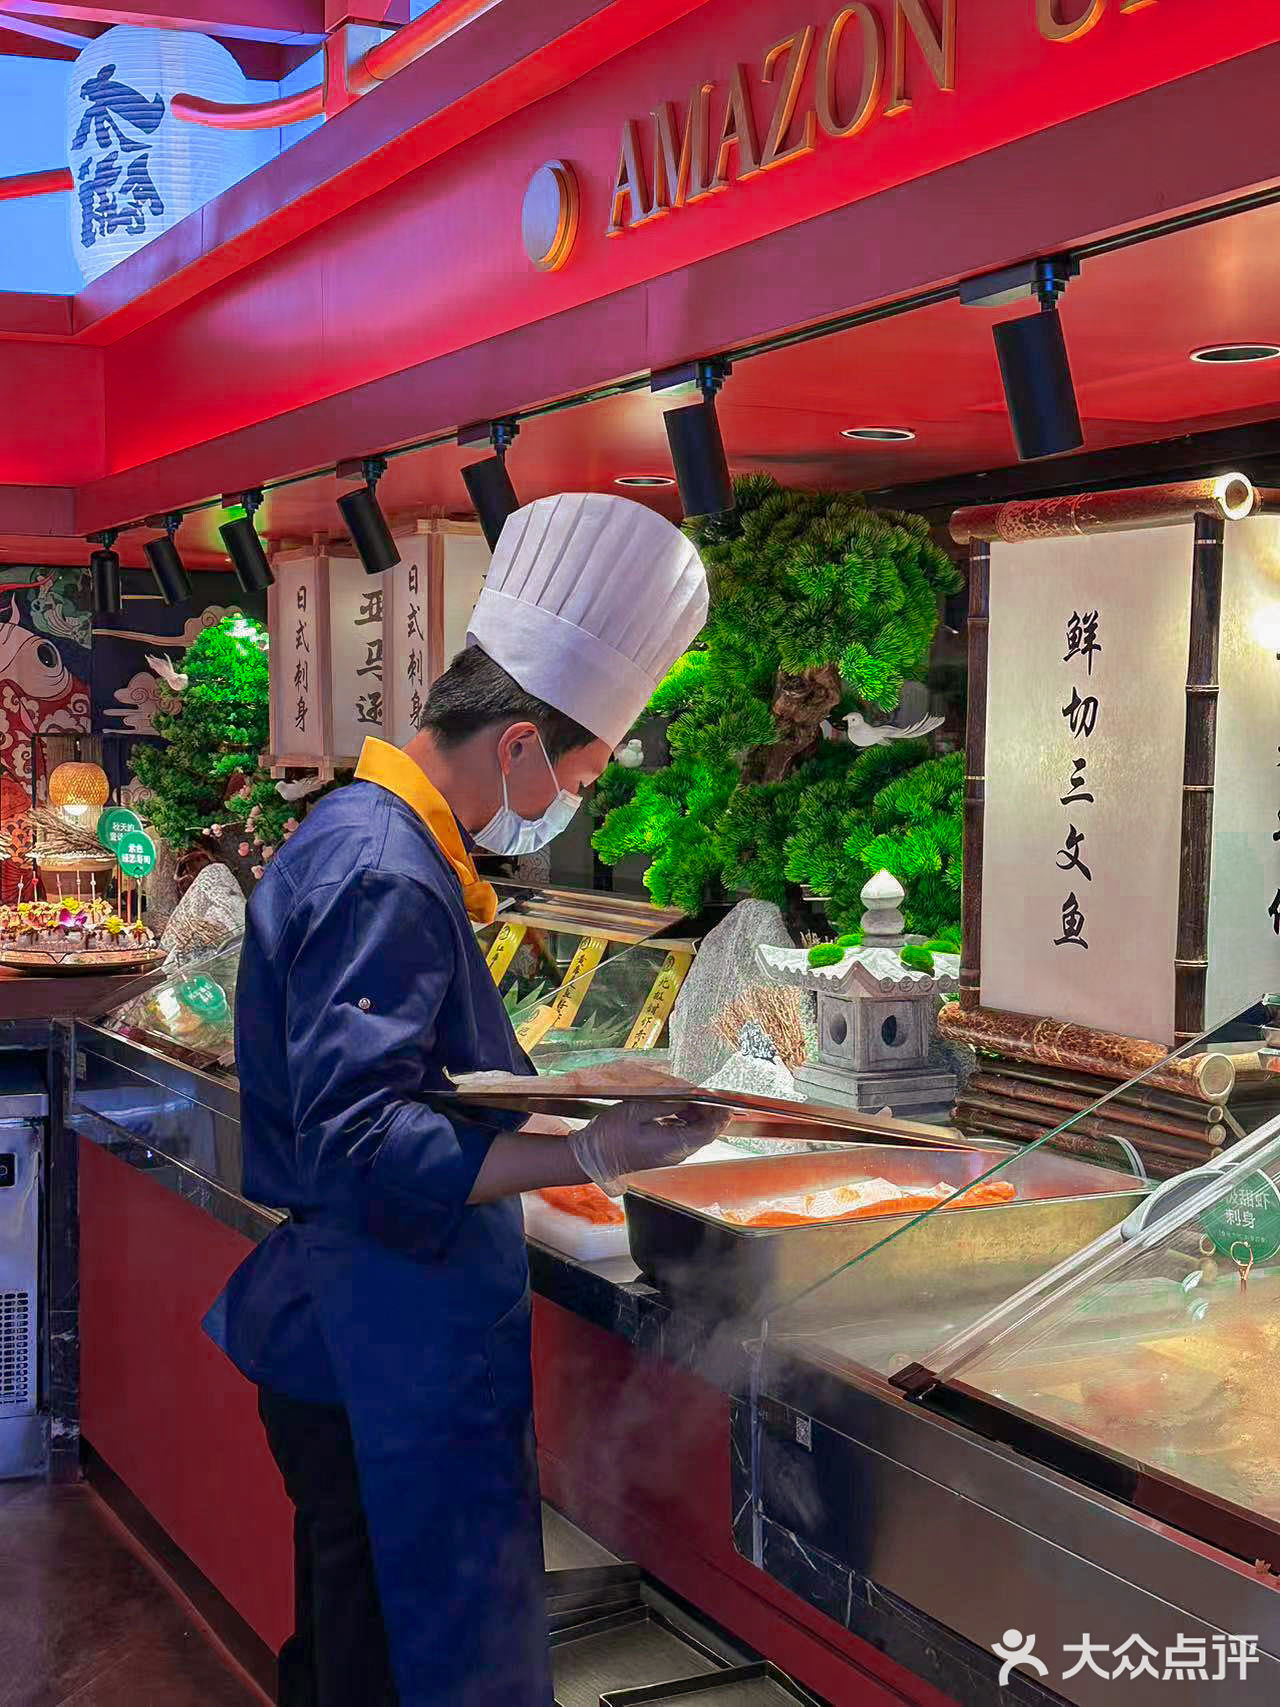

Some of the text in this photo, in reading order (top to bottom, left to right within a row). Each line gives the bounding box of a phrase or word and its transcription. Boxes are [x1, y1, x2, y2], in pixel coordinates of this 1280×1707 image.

[605, 0, 958, 238] AMAZON
[294, 585, 310, 733] 日式刺身
[407, 564, 424, 731] 日式刺身
[1053, 609, 1103, 950] 鲜切三文鱼
[1223, 1208, 1256, 1229] 刺身
